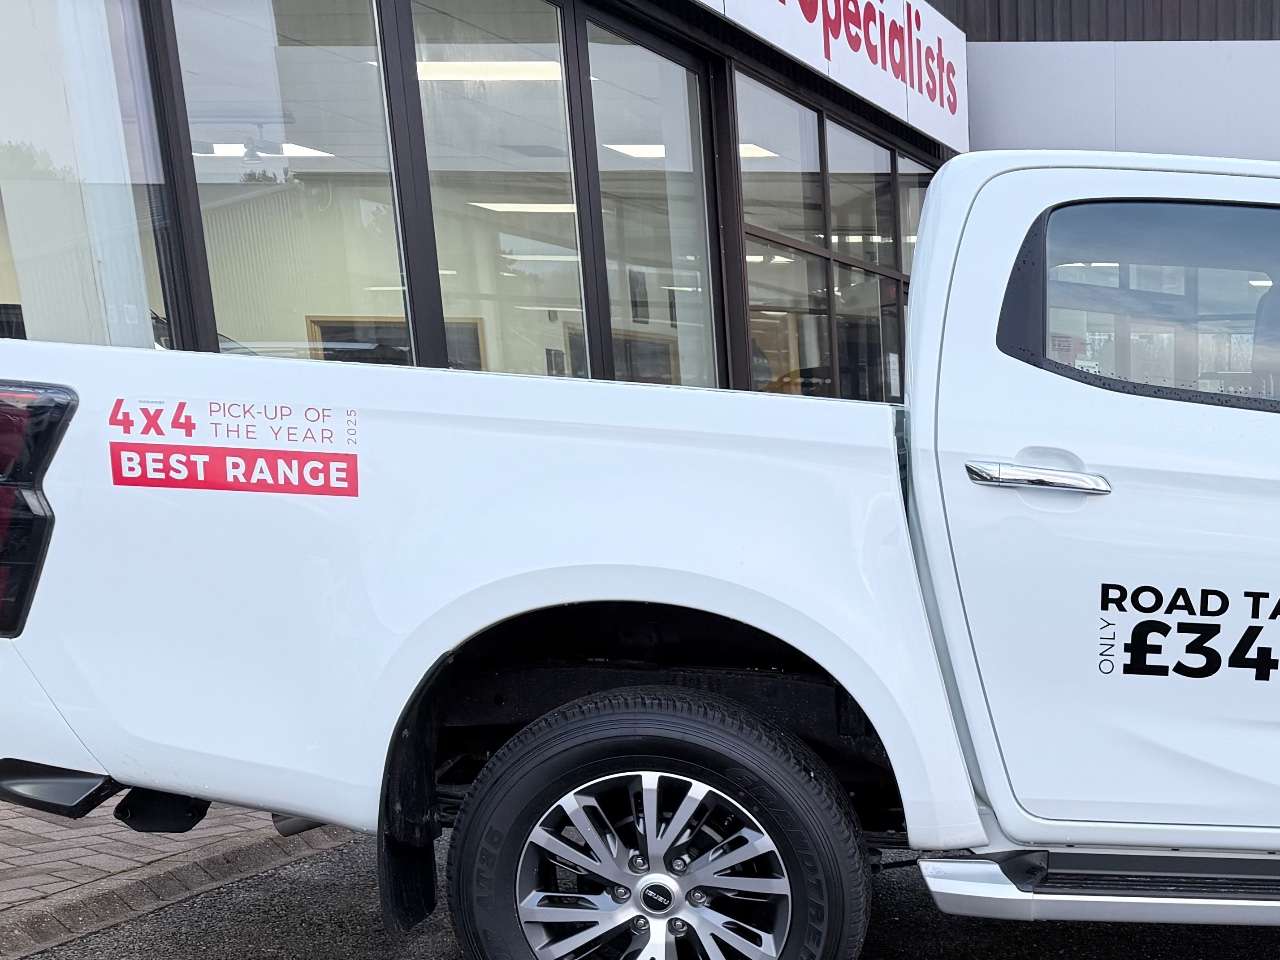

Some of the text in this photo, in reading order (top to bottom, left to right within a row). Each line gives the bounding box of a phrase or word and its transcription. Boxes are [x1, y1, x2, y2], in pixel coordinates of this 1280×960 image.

[798, 0, 958, 115] pecialists
[108, 398, 197, 438] 4x4
[208, 401, 333, 424] PICK-UP OF
[346, 408, 358, 446] 2025
[210, 422, 335, 444] THE YEAR
[119, 450, 349, 488] BEST RANGE
[1100, 583, 1230, 617] ROAD
[1098, 617, 1116, 675] ONLY
